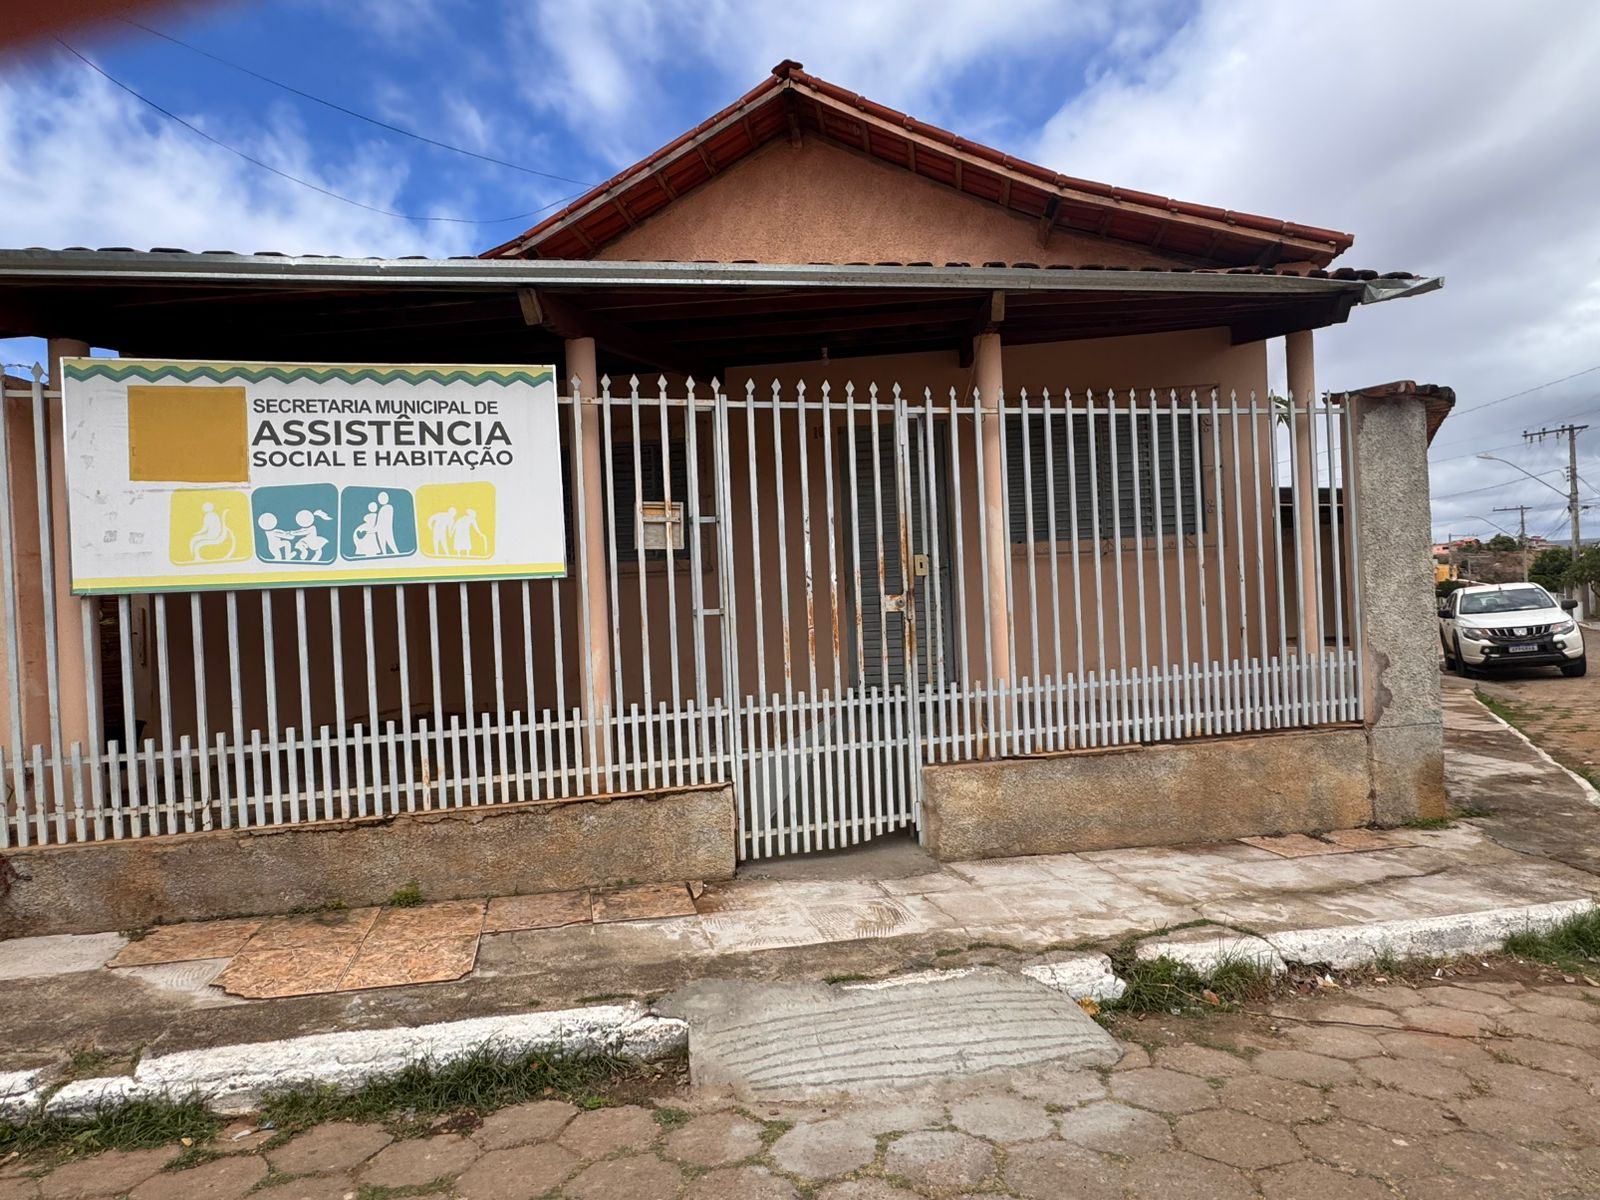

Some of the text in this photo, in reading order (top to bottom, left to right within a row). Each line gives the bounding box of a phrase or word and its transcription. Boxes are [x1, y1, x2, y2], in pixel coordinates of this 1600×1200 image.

[253, 399, 498, 414] SECRETARIA MUNICIPAL DE
[252, 414, 512, 446] ASSISTÊNCIA
[252, 446, 513, 471] SOCIAL E HABITAÇÃO
